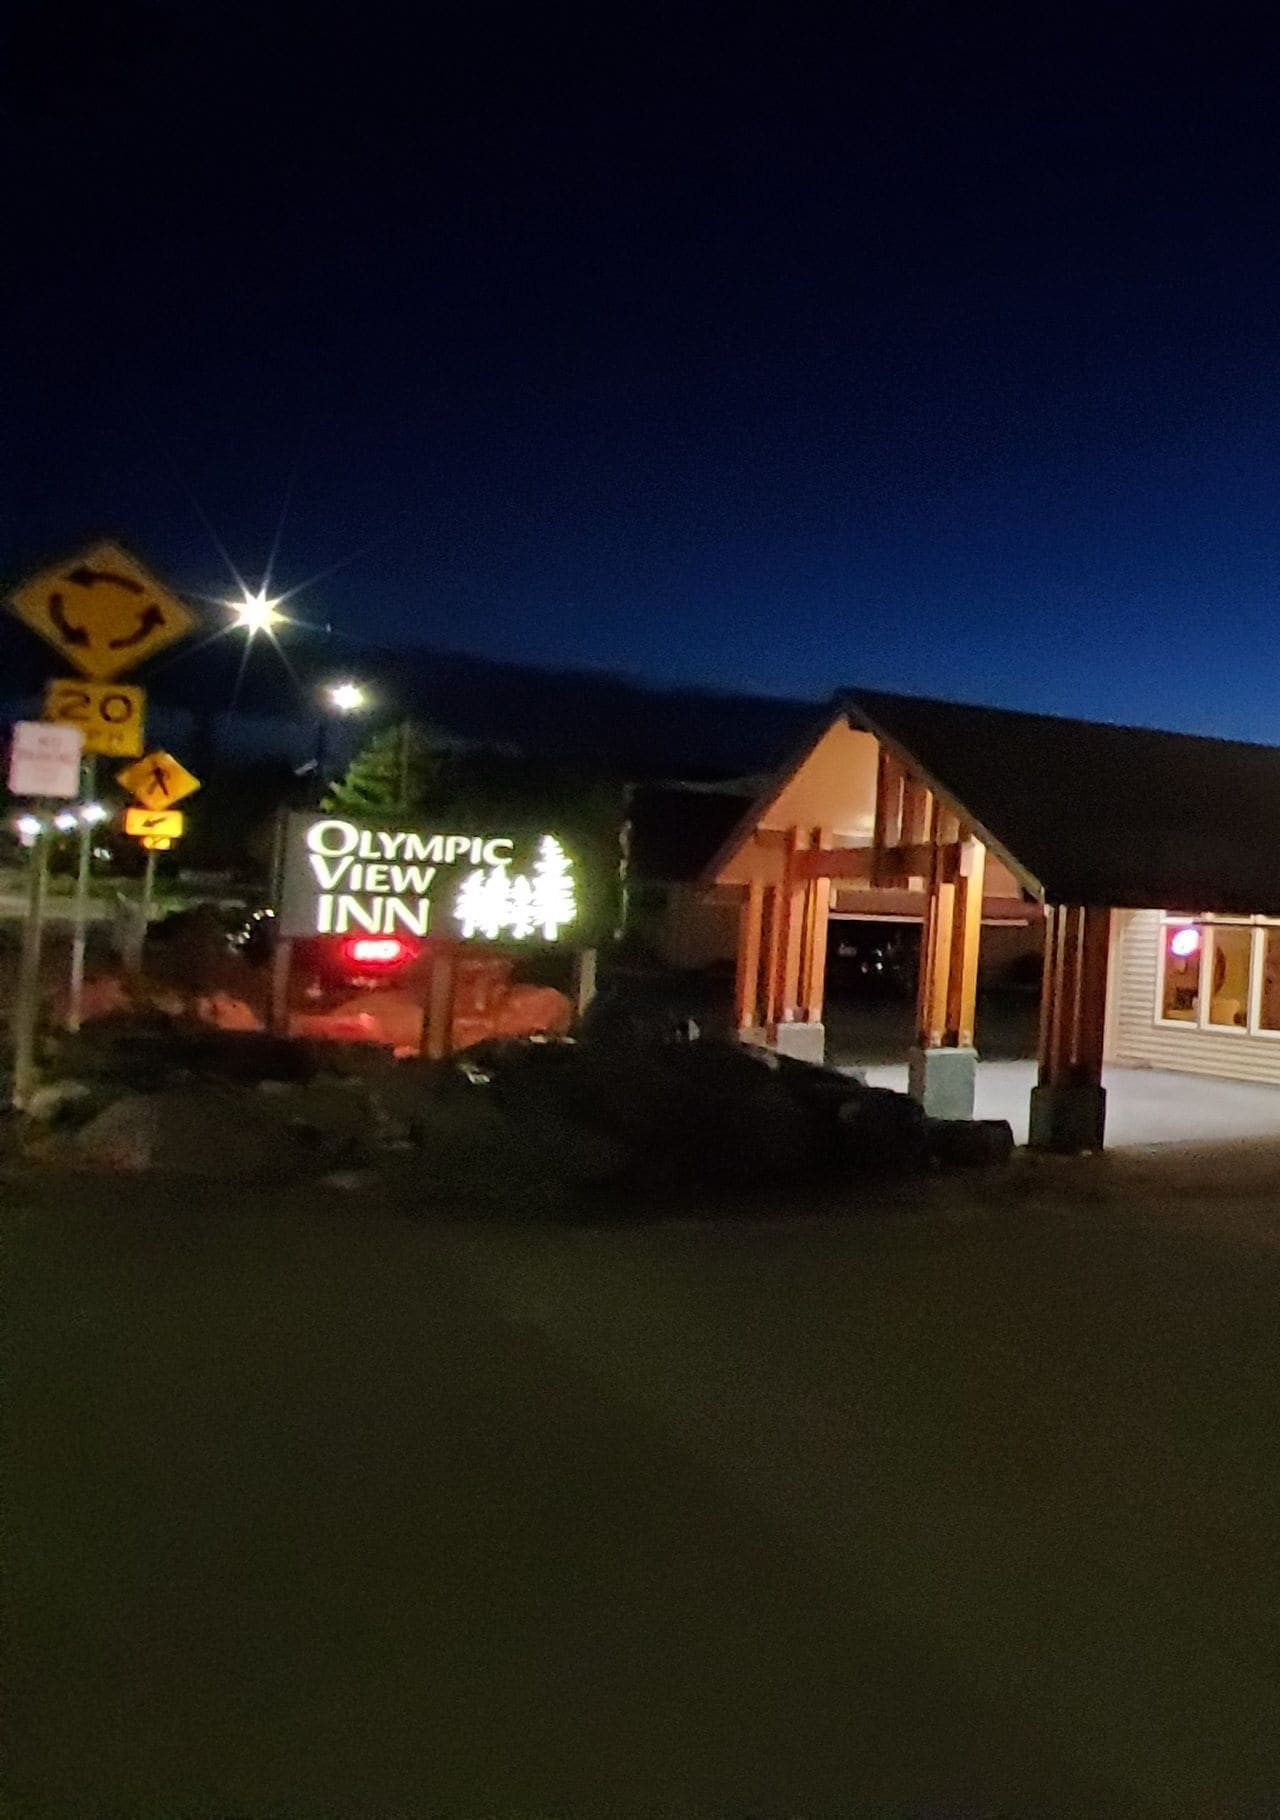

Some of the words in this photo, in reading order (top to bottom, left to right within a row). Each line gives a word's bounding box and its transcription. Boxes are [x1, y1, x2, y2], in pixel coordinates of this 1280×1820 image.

[58, 689, 132, 723] 20
[306, 820, 514, 866] OLYMPIC
[309, 854, 436, 894] VIEW
[317, 894, 430, 937] INN
